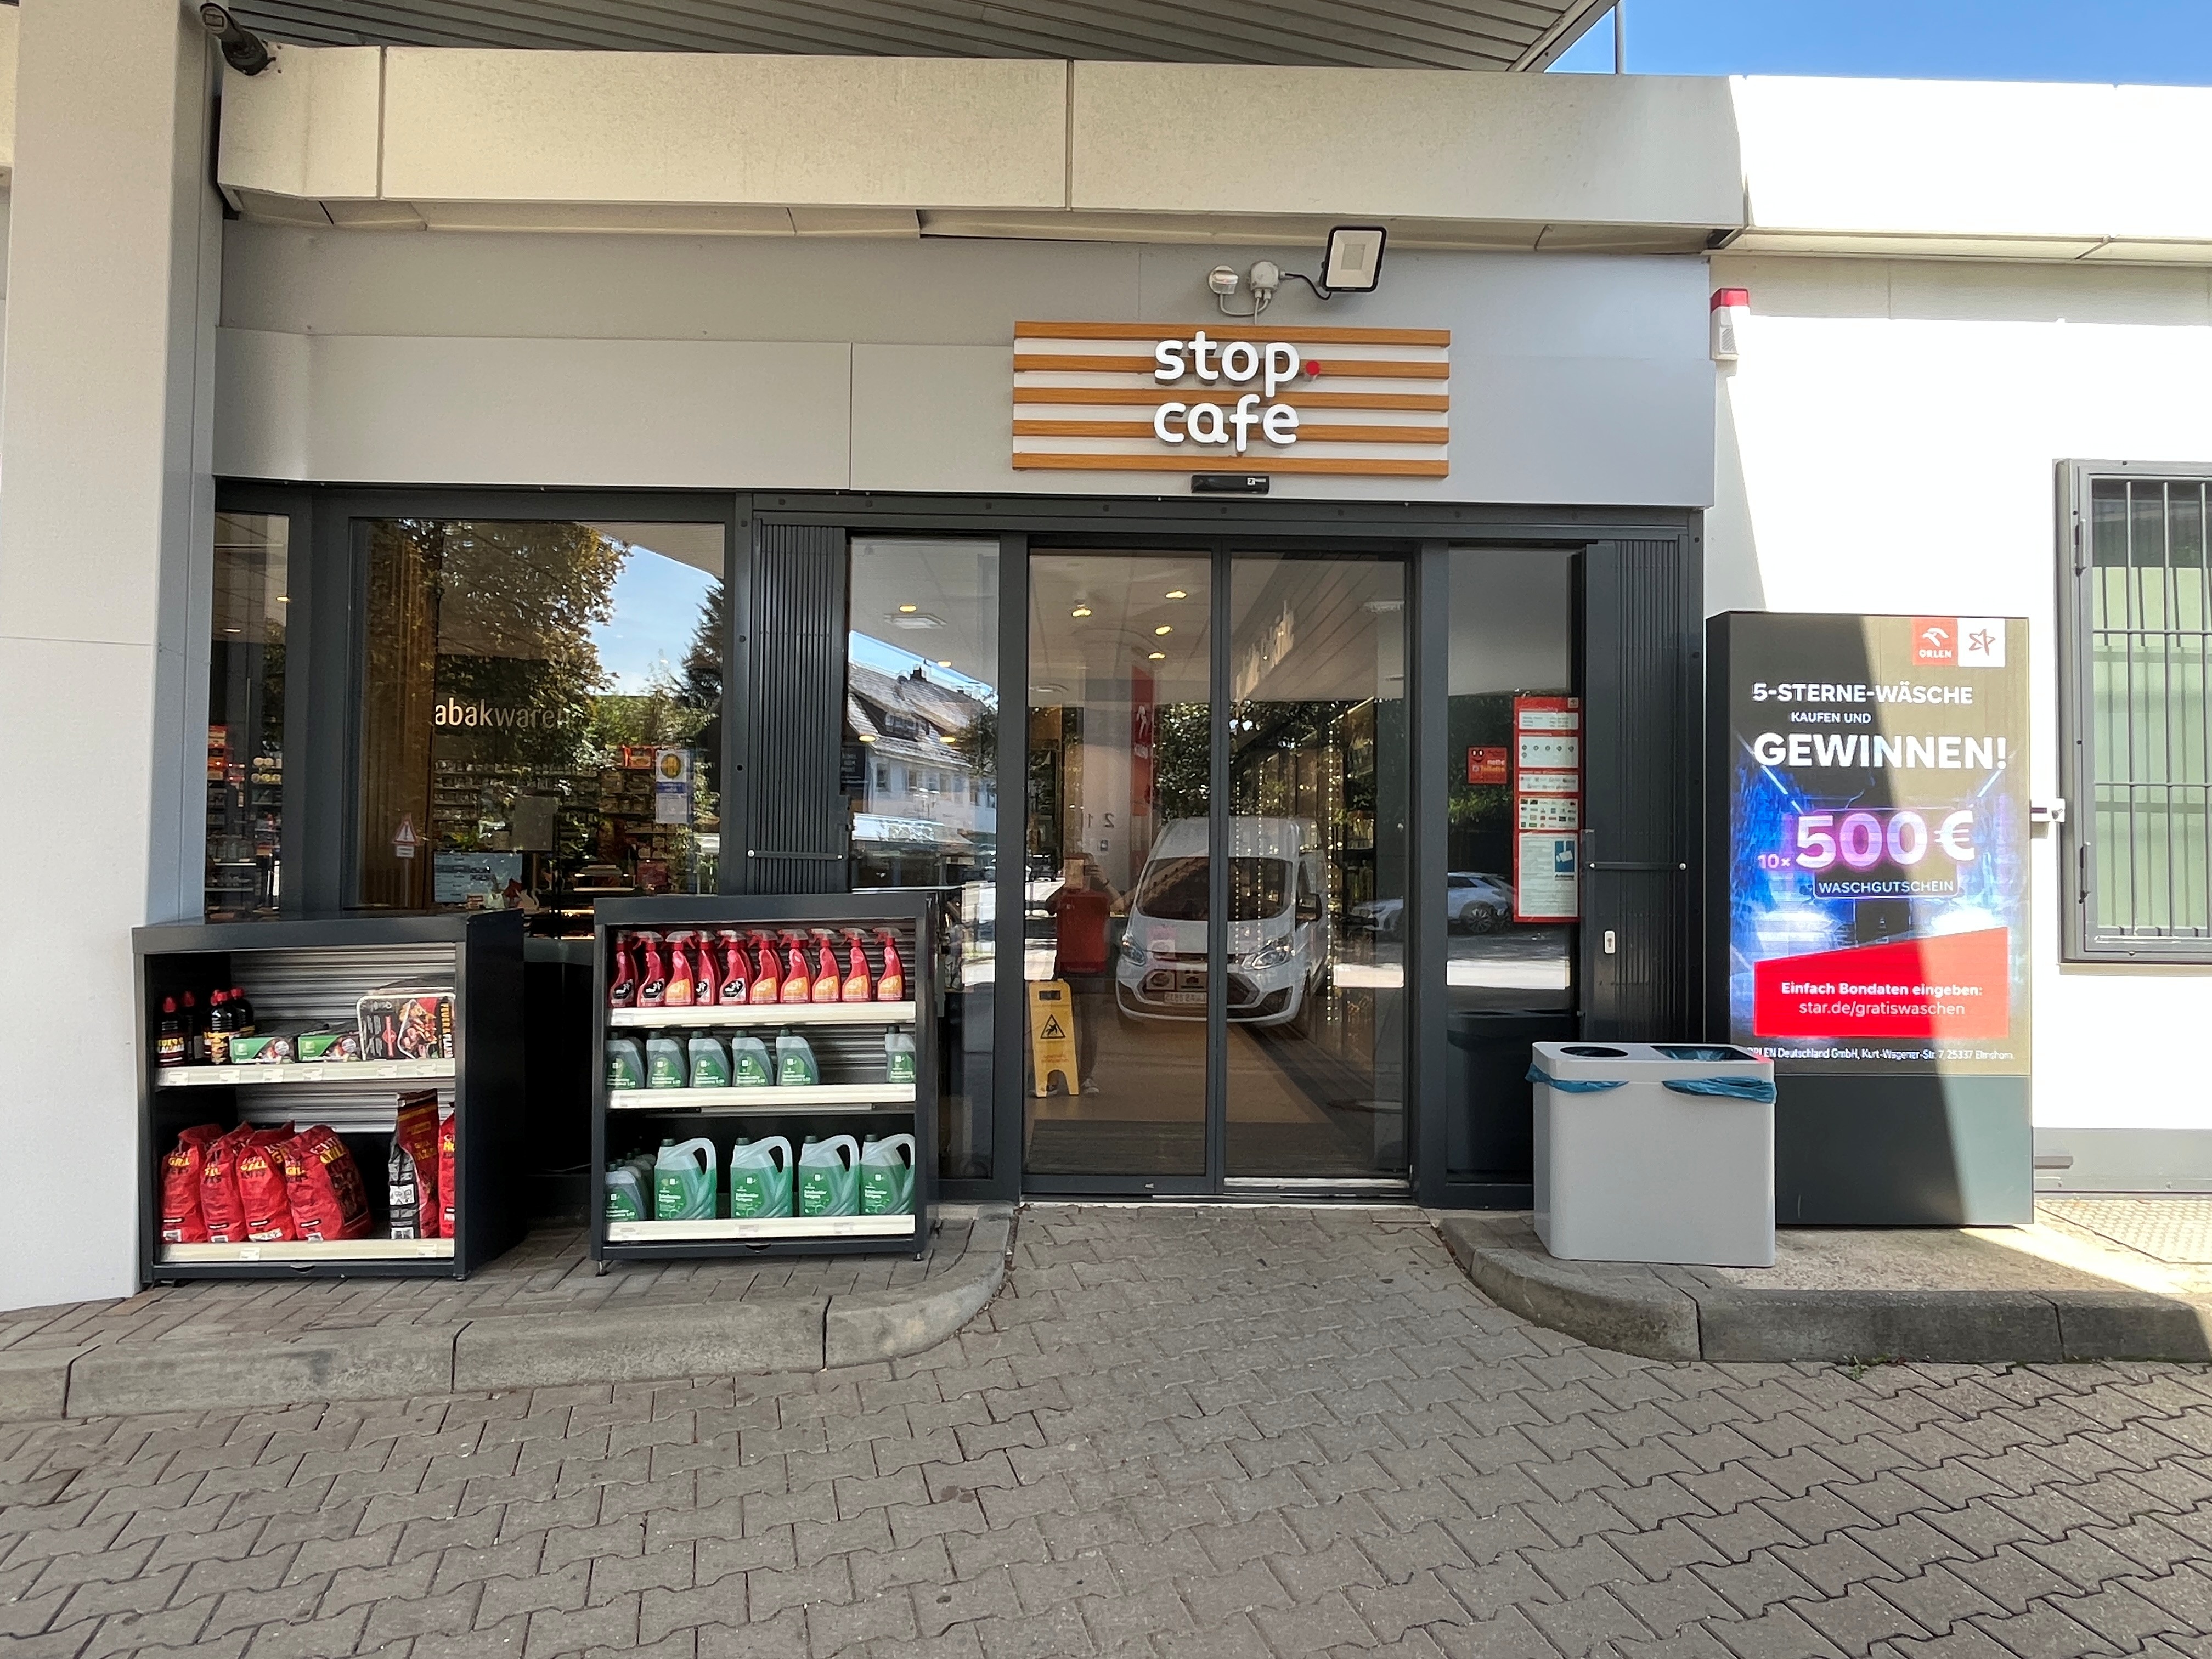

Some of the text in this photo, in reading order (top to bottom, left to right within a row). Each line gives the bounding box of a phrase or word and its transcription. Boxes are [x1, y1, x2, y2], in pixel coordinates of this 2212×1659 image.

[1153, 394, 1300, 453] cafe
[1918, 649, 1952, 658] ORLEN
[1752, 680, 1974, 704] 5-STERNE-WÄSCHE
[1790, 711, 1872, 724] KAUFEN UND
[1753, 732, 2007, 769] GEWINNEN!
[1757, 810, 1976, 869] 10x 500€
[1818, 880, 1954, 894] WASCHGUTSCHEIN
[1781, 982, 1983, 998] Einfach Bondaten eingeben:
[1799, 1001, 1966, 1017] star.de/gratiswaschen
[1778, 1047, 1830, 1059] Deutschland
[1831, 1047, 1861, 1060] GmbH,
